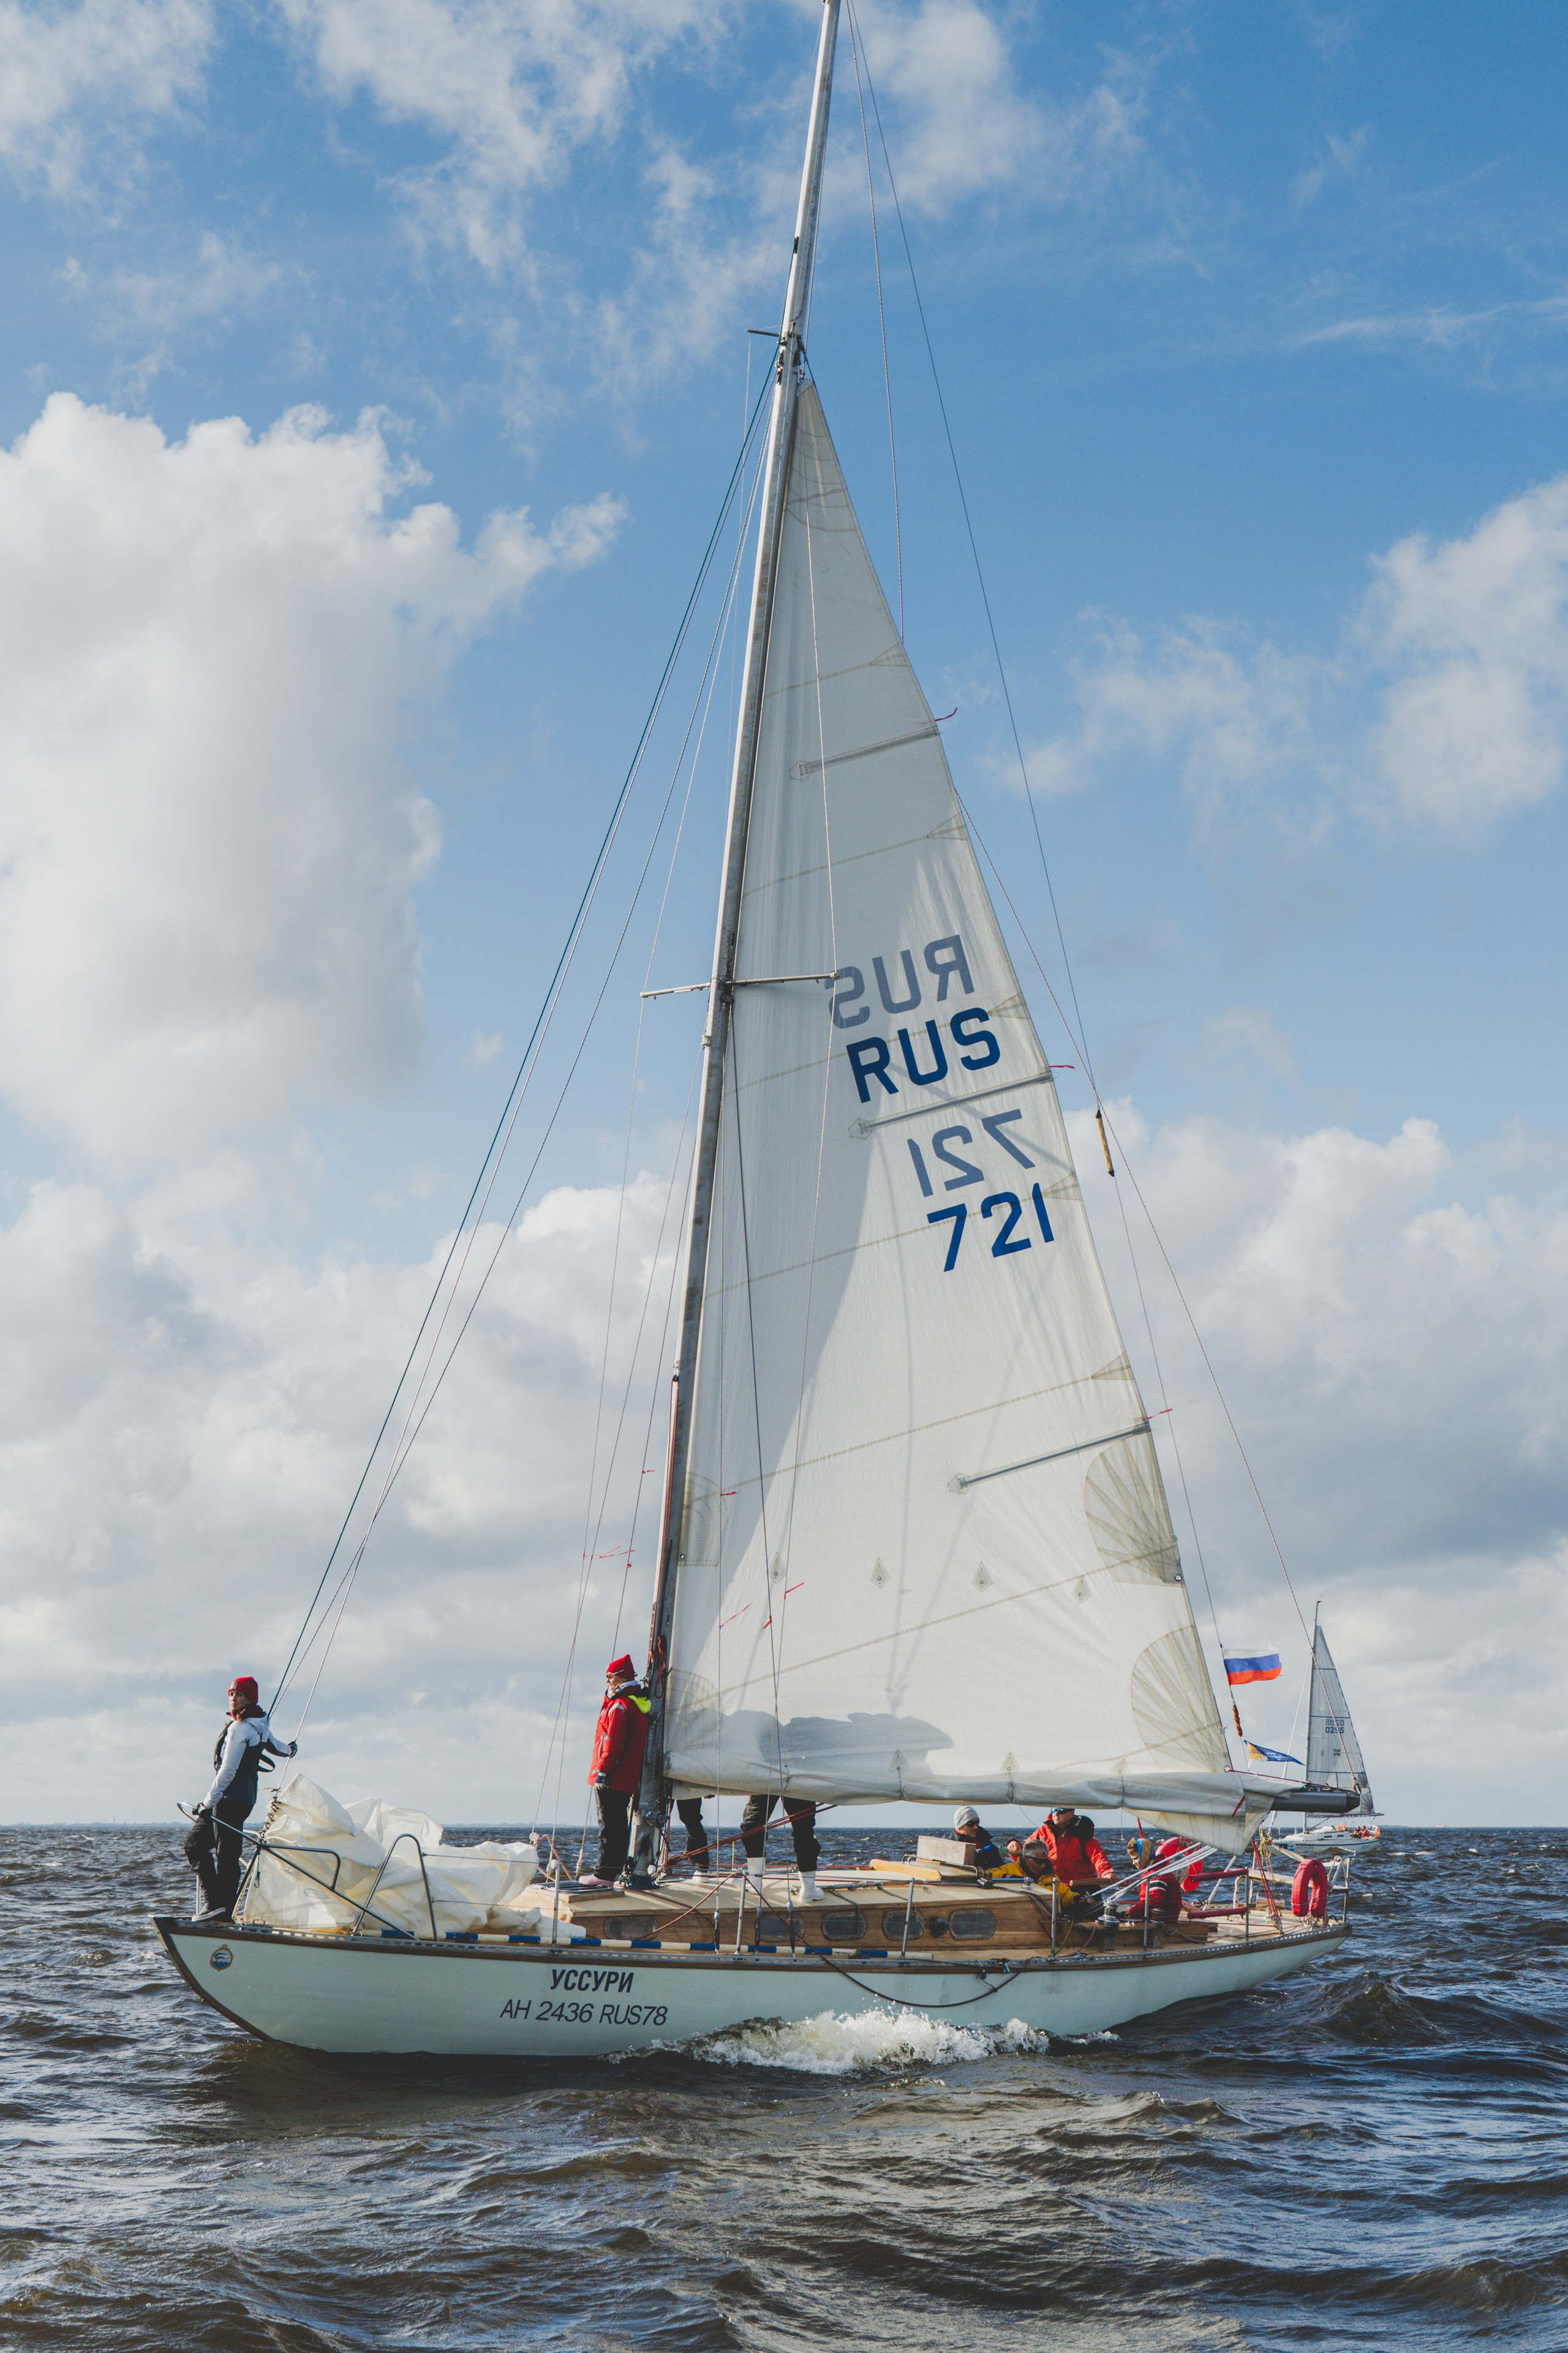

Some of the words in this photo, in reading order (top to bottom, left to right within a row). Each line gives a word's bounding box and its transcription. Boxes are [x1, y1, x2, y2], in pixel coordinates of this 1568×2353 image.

[846, 1007, 1000, 1103] RUS
[927, 1182, 1054, 1272] 721
[550, 1968, 635, 1993] УССУРИ
[535, 2001, 594, 2023] 2436
[598, 2004, 668, 2026] RUS78
